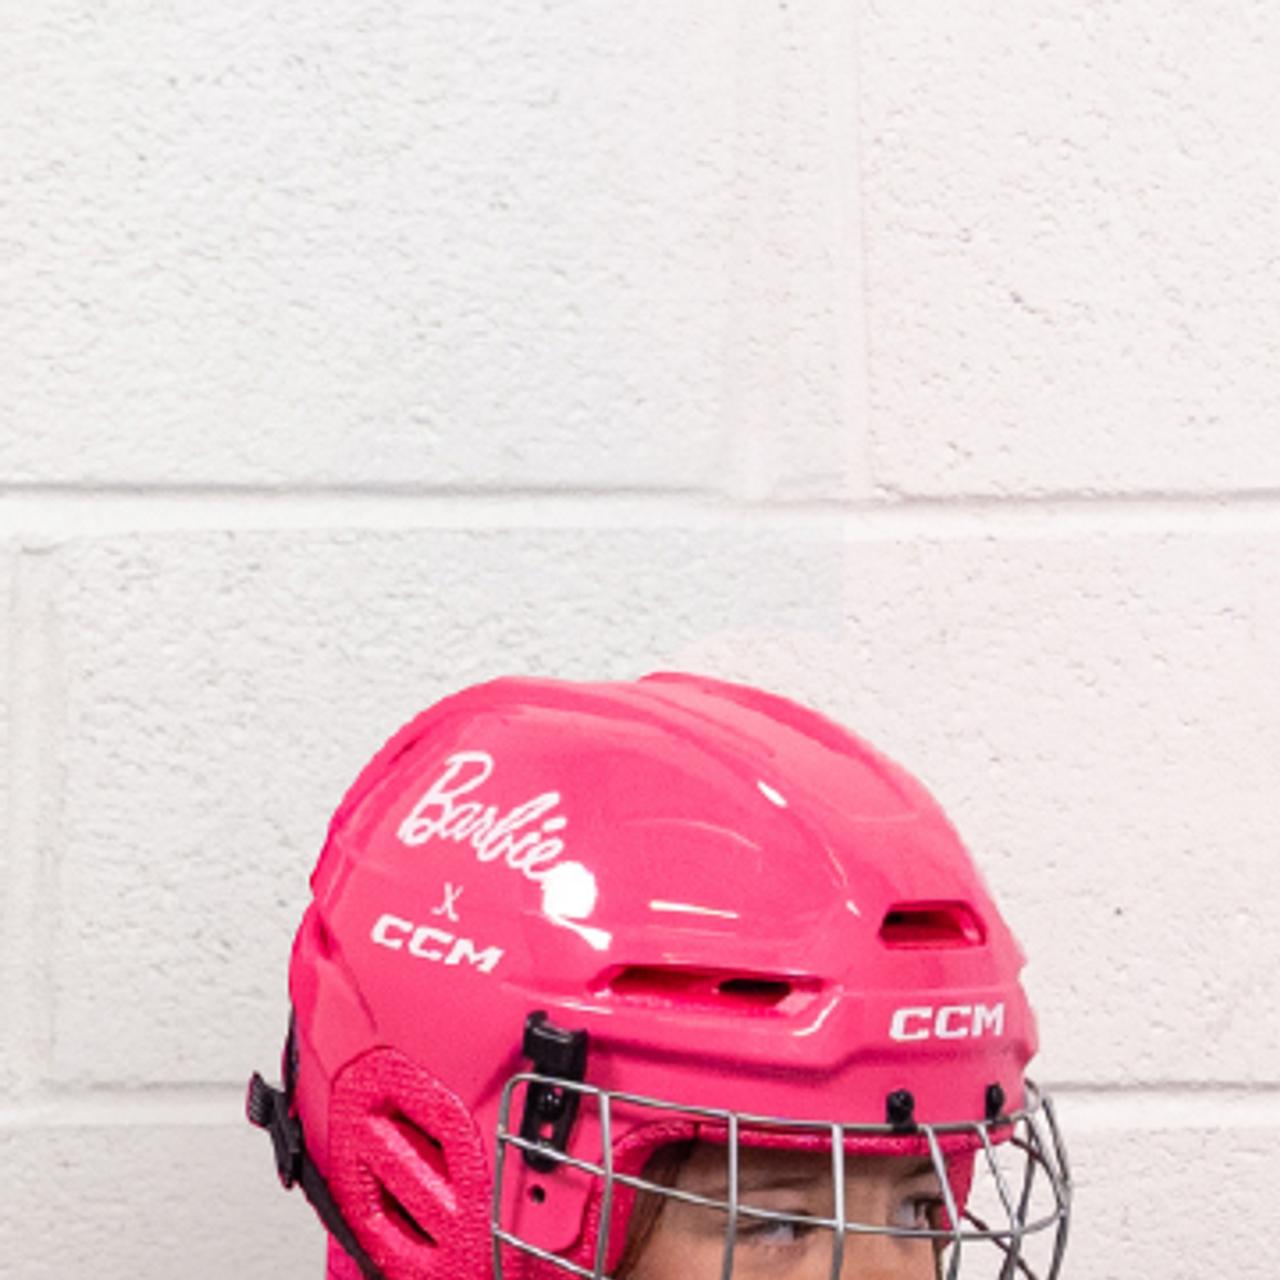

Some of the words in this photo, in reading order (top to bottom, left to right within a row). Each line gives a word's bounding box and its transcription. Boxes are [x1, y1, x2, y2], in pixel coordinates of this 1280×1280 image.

[396, 751, 568, 881] Barbie
[370, 913, 504, 973] CCM
[889, 1003, 1005, 1041] CCM
